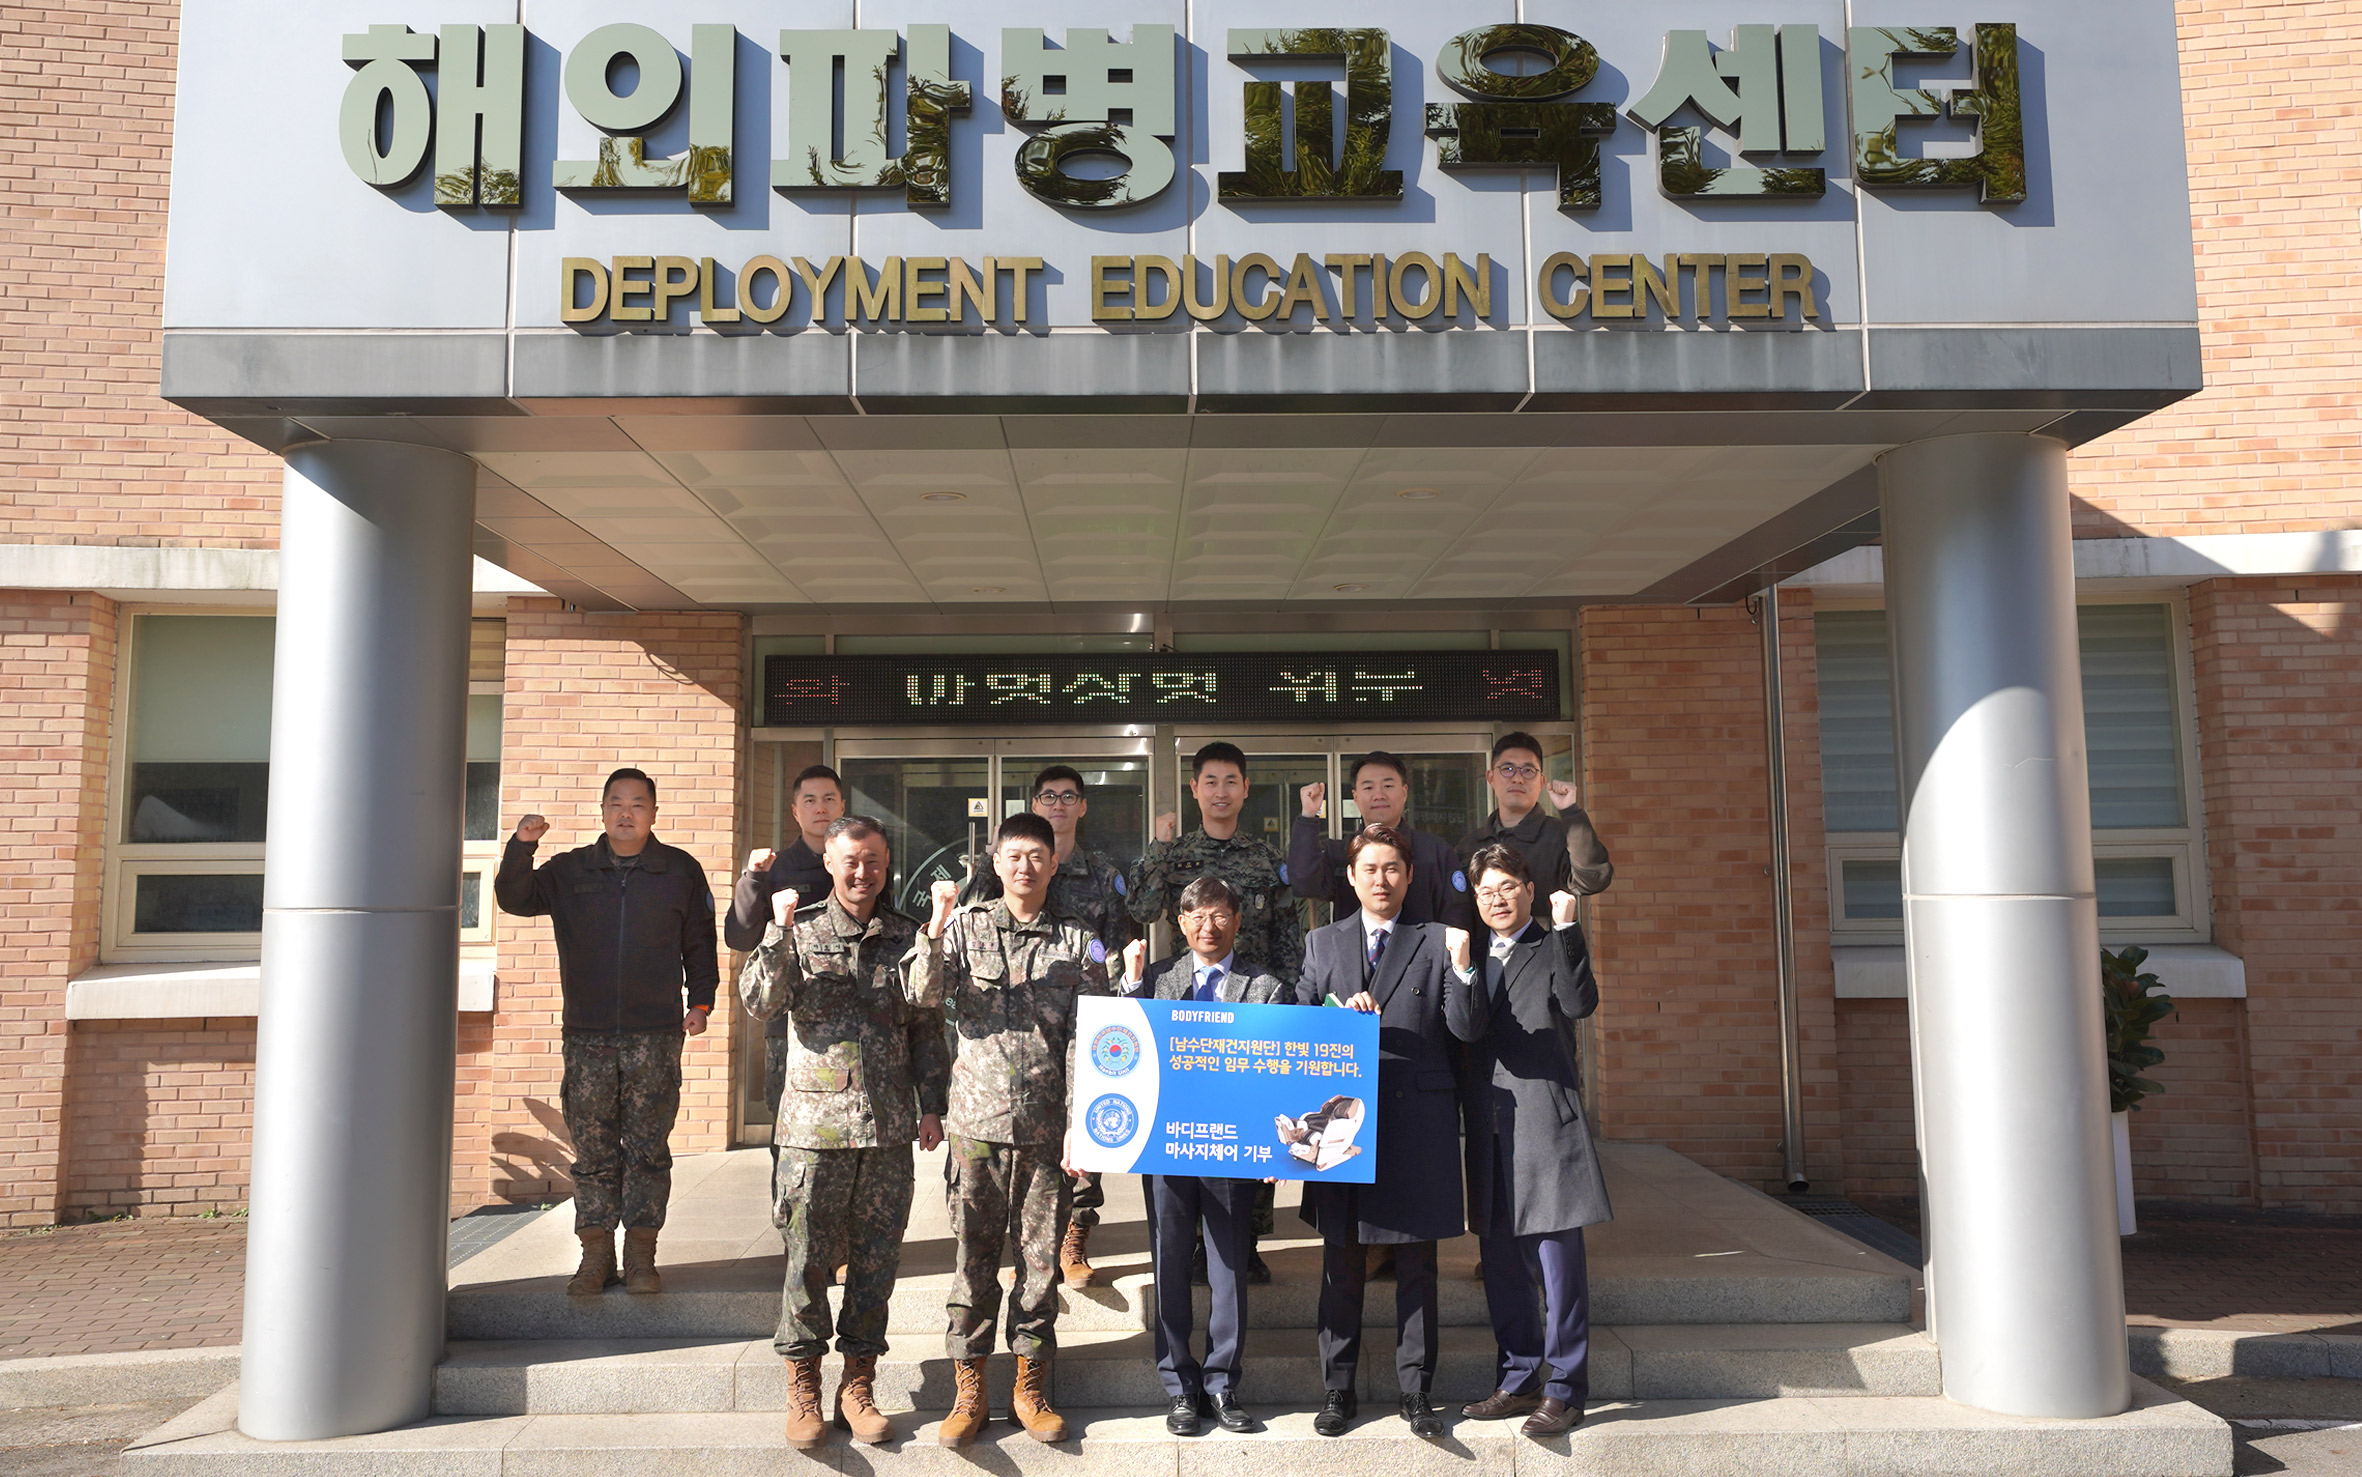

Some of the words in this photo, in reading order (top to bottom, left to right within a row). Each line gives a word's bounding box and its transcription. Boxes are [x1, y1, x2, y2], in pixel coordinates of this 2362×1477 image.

[340, 21, 2025, 208] 해외파병교육센터
[561, 254, 1043, 324] DEPLOYMENT
[1092, 252, 1490, 321] EDUCATION
[1539, 251, 1817, 320] CENTER
[1171, 1009, 1235, 1024] BODYFRIEND
[1169, 1037, 1280, 1056] [남수단재건지원단]
[1284, 1042, 1310, 1057] 한빛
[1314, 1043, 1354, 1059] 19진의
[1169, 1055, 1220, 1071] 성공적인
[1224, 1057, 1250, 1073] 임무
[1253, 1059, 1292, 1075] 수행을
[1295, 1061, 1363, 1078] 기원합니다.
[1166, 1121, 1239, 1140] 바디프랜드
[1165, 1142, 1239, 1162] 마사지체어
[1244, 1146, 1273, 1163] 기부
